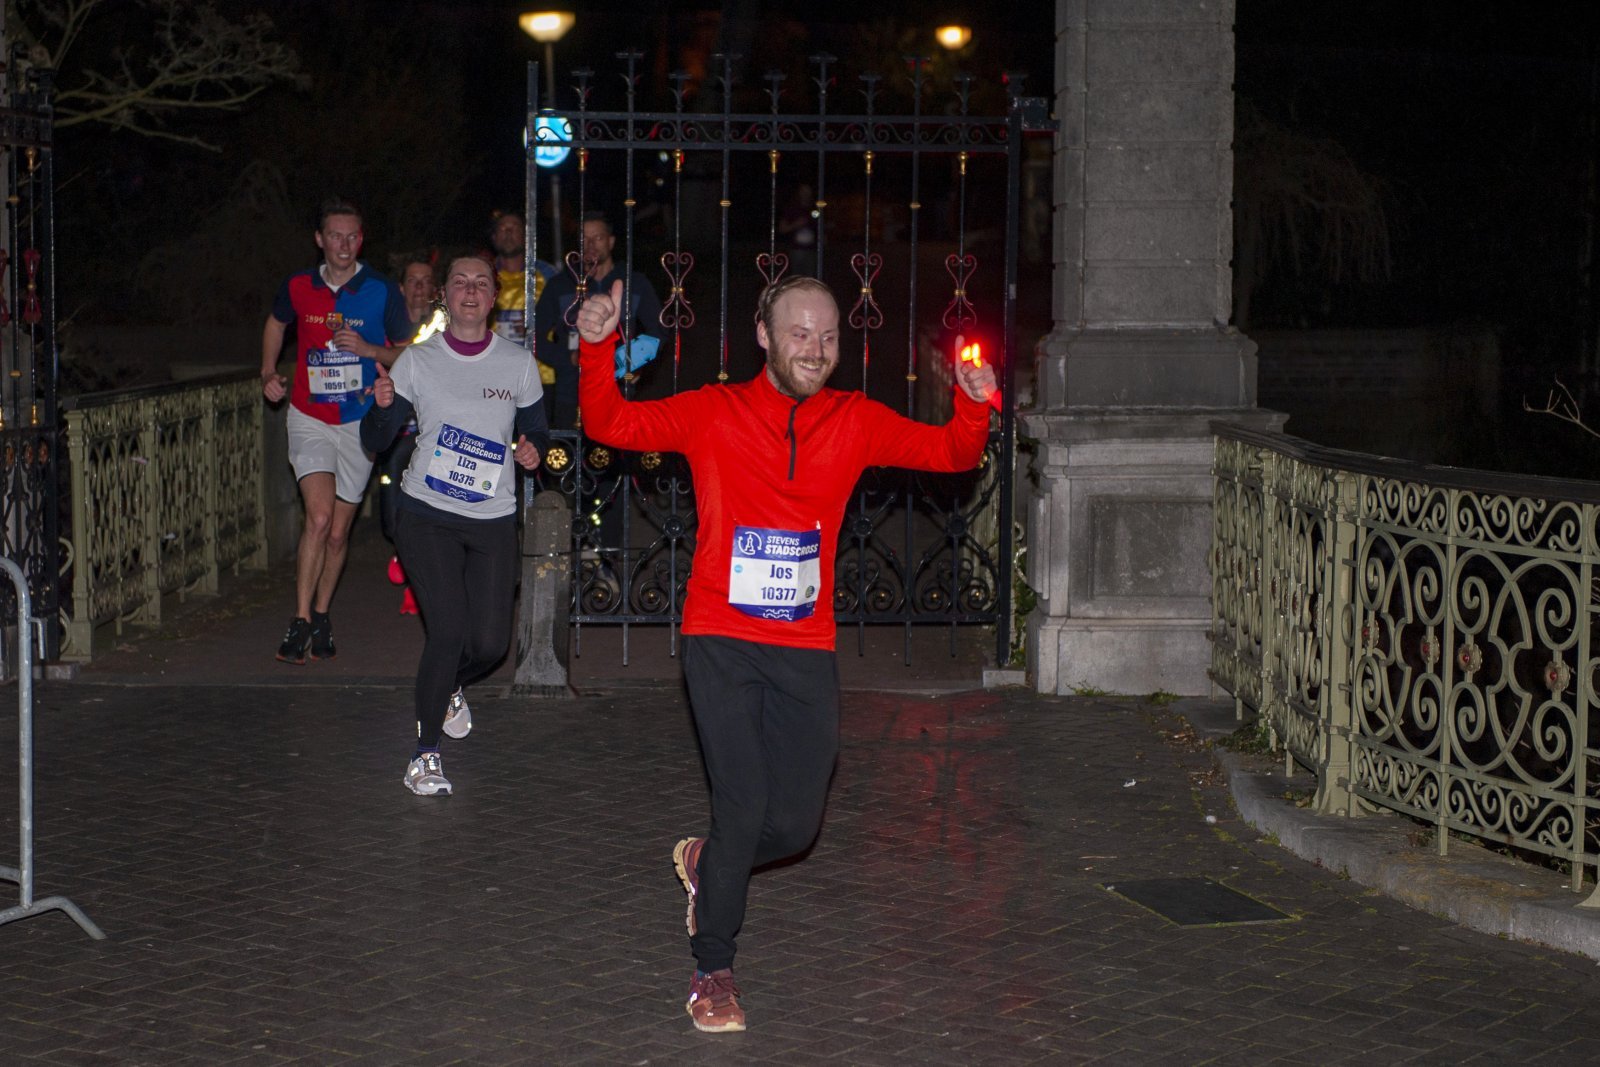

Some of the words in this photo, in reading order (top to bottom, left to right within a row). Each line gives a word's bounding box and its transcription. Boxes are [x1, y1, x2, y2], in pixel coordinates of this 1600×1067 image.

[462, 436, 486, 448] STEVENS
[459, 442, 503, 461] STADSCROSS
[456, 456, 478, 471] Liza
[448, 470, 475, 486] 10375
[766, 535, 800, 545] STEVENS
[764, 544, 818, 556] STADSCROSS
[761, 587, 797, 600] 10377
